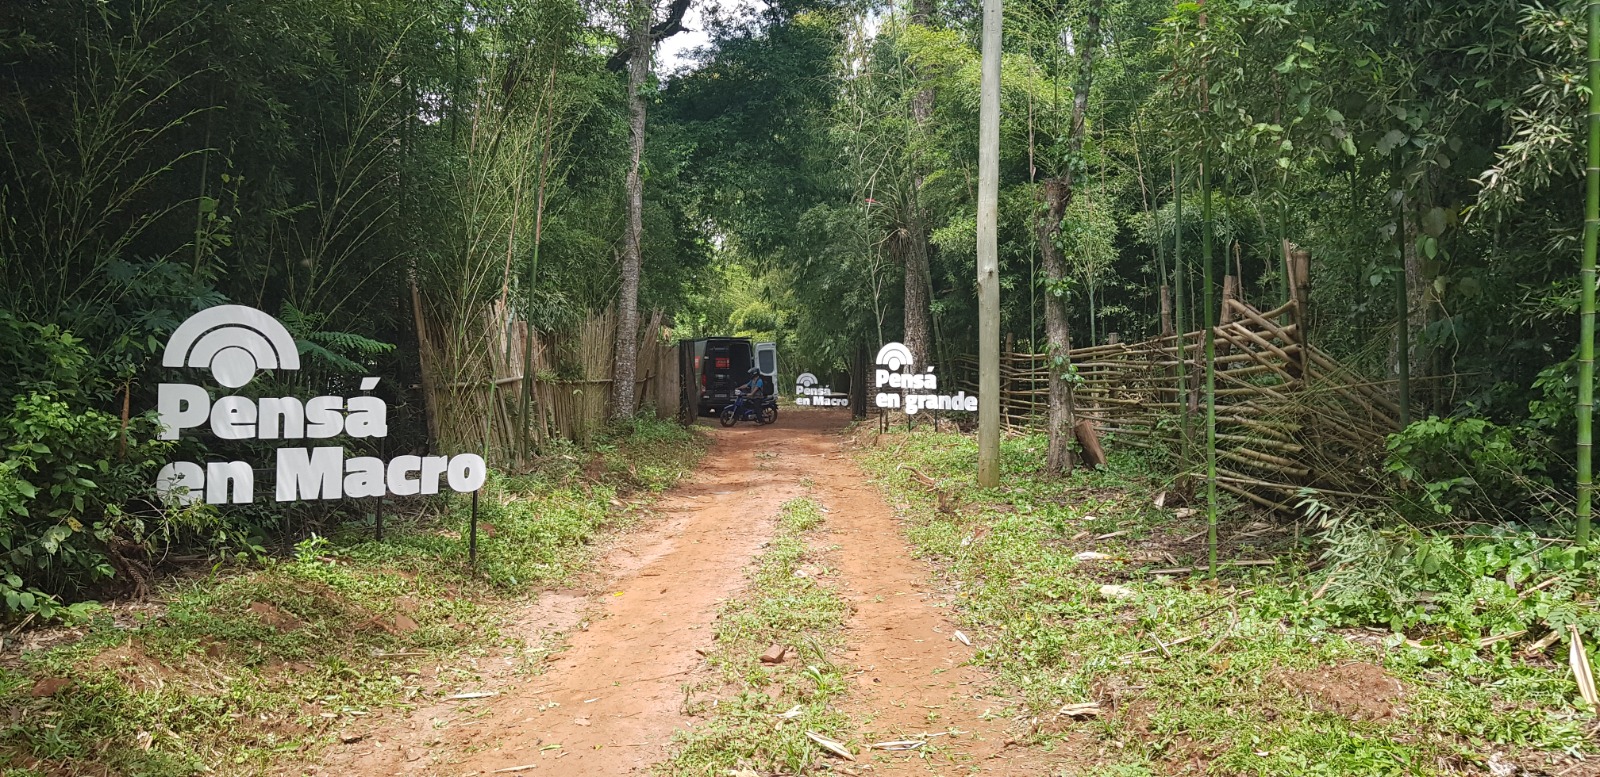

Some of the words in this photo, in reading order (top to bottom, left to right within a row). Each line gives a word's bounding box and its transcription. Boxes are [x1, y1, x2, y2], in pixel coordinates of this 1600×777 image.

[876, 366, 937, 389] Pensá
[796, 385, 831, 396] Pensá
[796, 398, 810, 406] en
[813, 396, 848, 406] Macro
[158, 377, 387, 440] Pensá
[876, 393, 900, 408] en
[905, 391, 978, 415] grande
[156, 461, 254, 505] en
[276, 447, 486, 502] Macro
